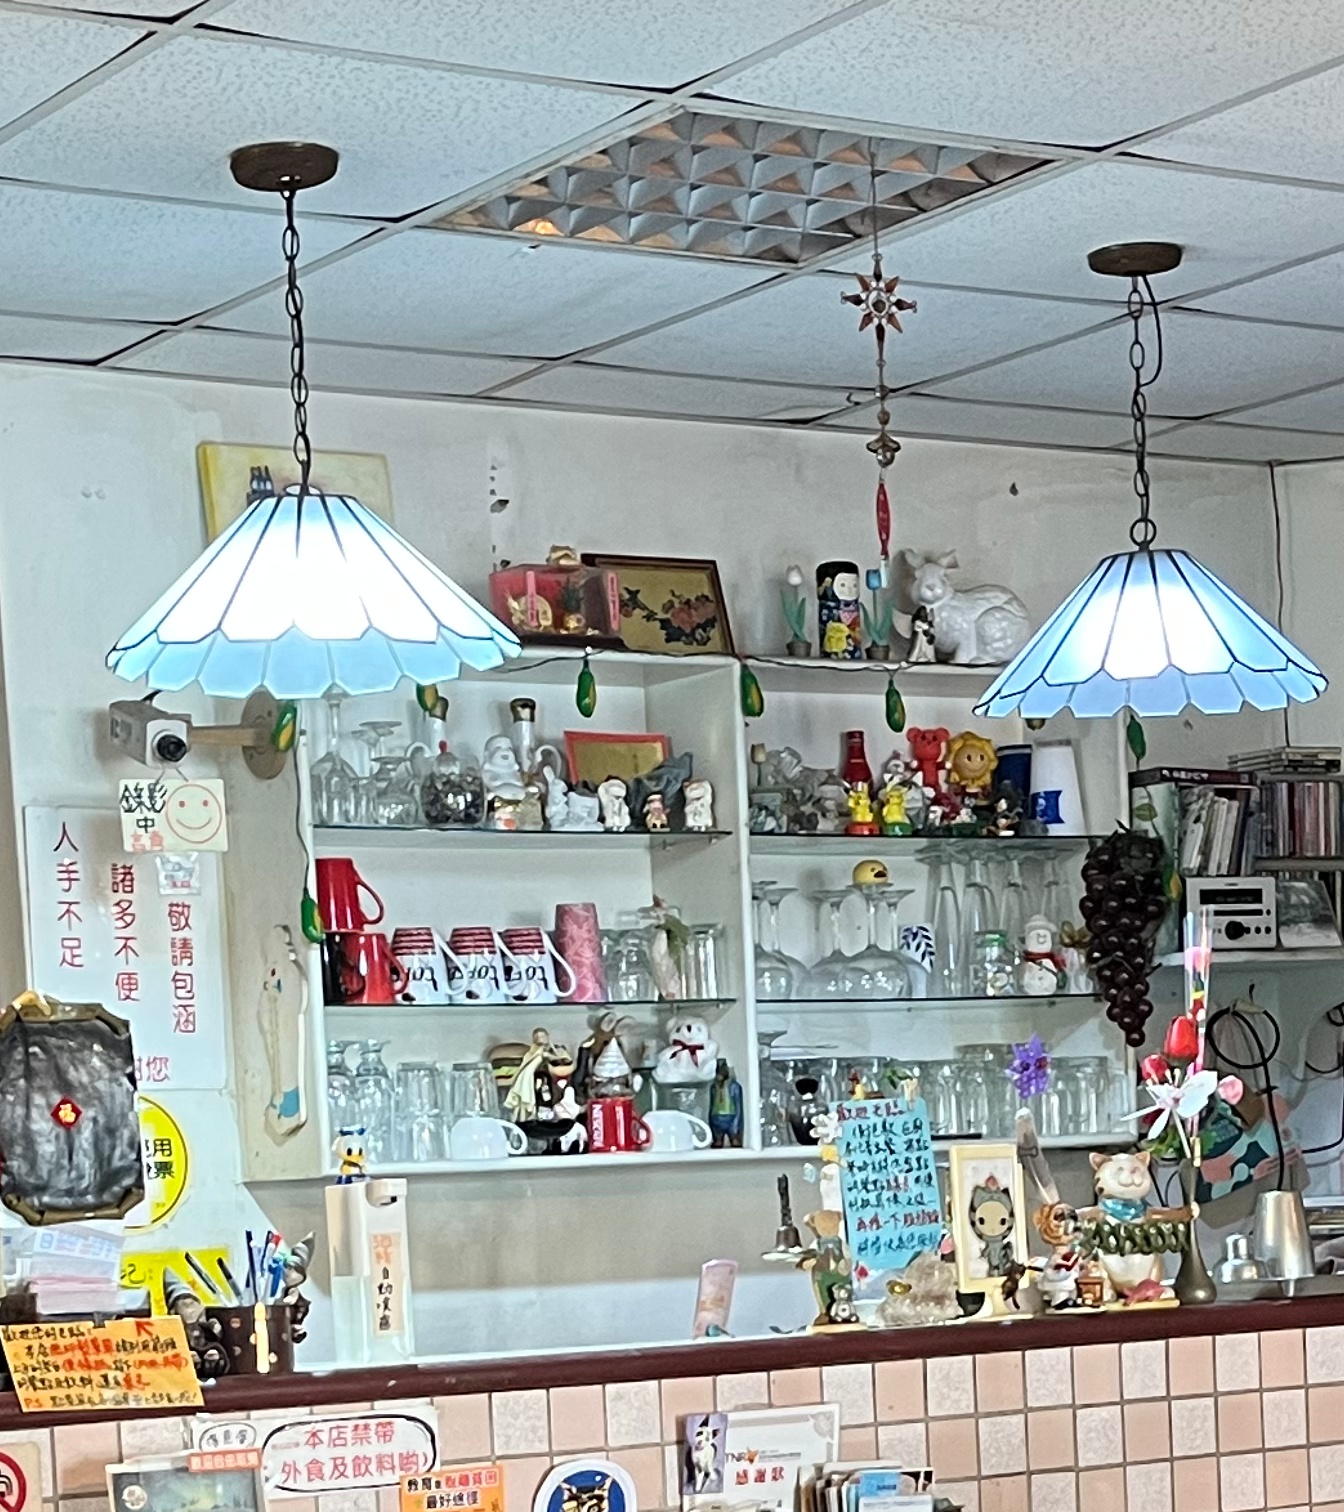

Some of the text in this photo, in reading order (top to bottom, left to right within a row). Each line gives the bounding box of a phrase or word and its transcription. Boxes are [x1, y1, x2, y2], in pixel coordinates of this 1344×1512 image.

[136, 816, 155, 833] 中
[53, 821, 84, 968] 人手不足
[111, 863, 140, 1002] 諸多不便
[167, 902, 197, 1034] 敬請包涵
[134, 1056, 171, 1083] 您
[304, 1420, 395, 1450] 本店禁帶
